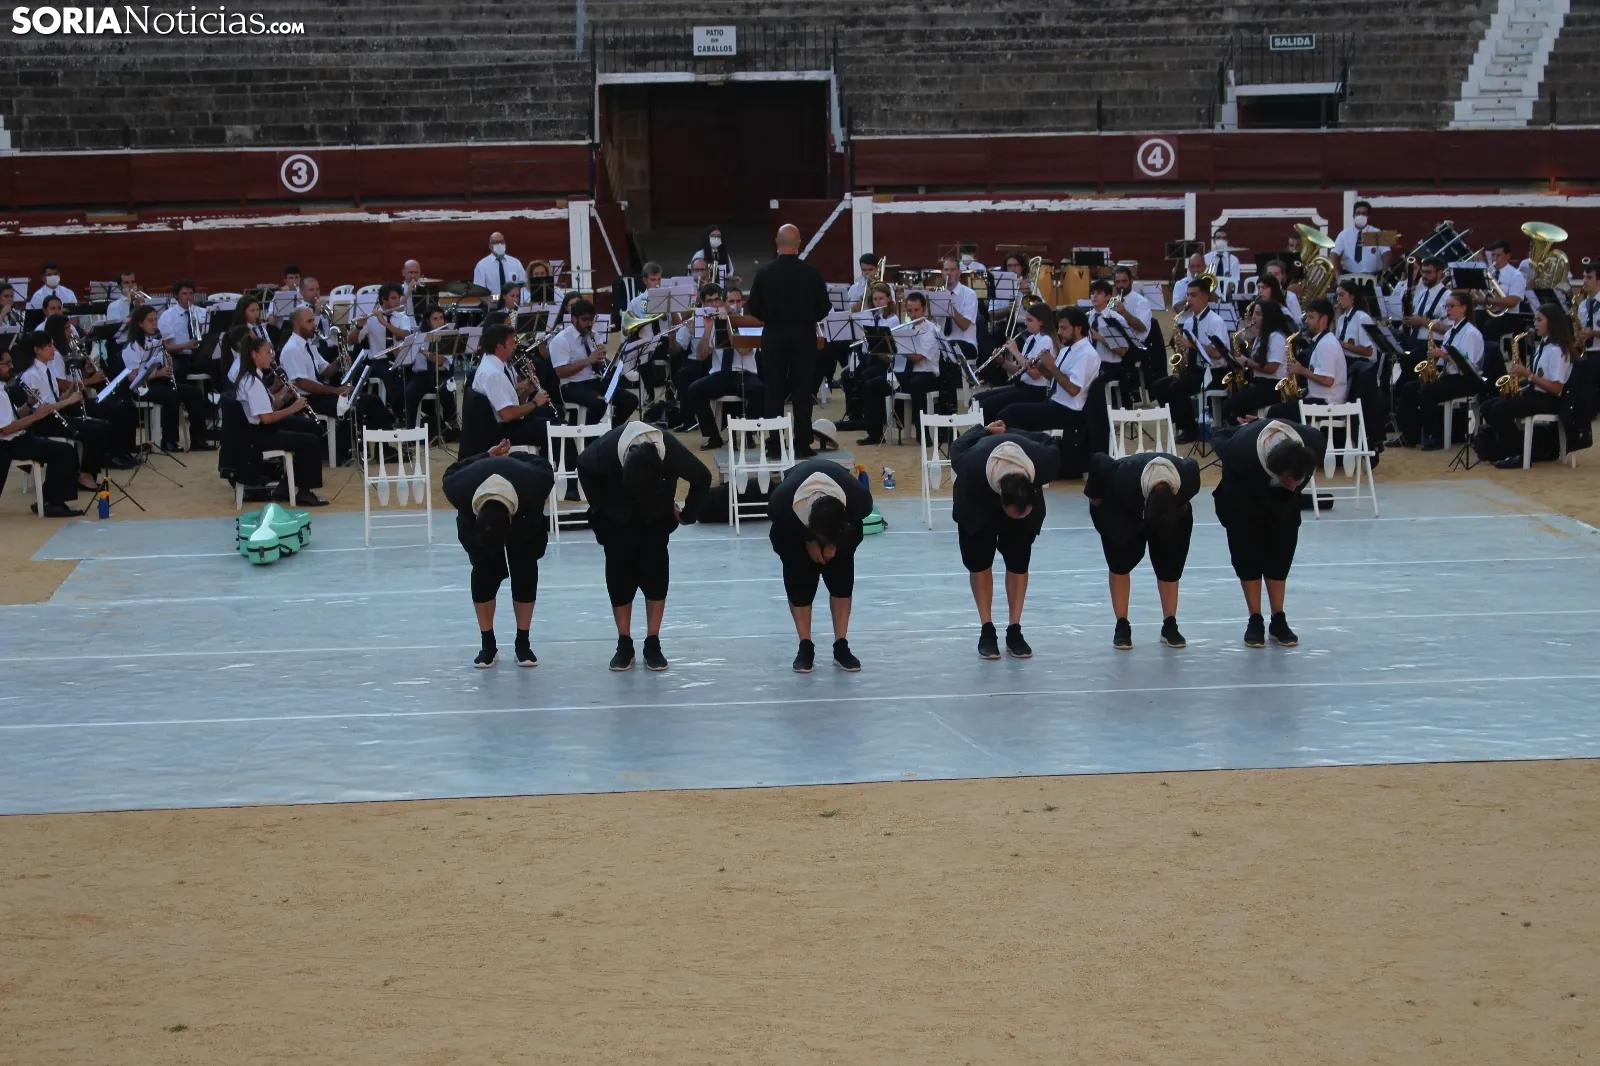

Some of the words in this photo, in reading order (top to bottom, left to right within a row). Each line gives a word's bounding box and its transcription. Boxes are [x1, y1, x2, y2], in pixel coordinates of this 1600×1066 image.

[1274, 36, 1311, 47] SALIDA
[1147, 146, 1164, 169] 4
[291, 161, 308, 185] 3
